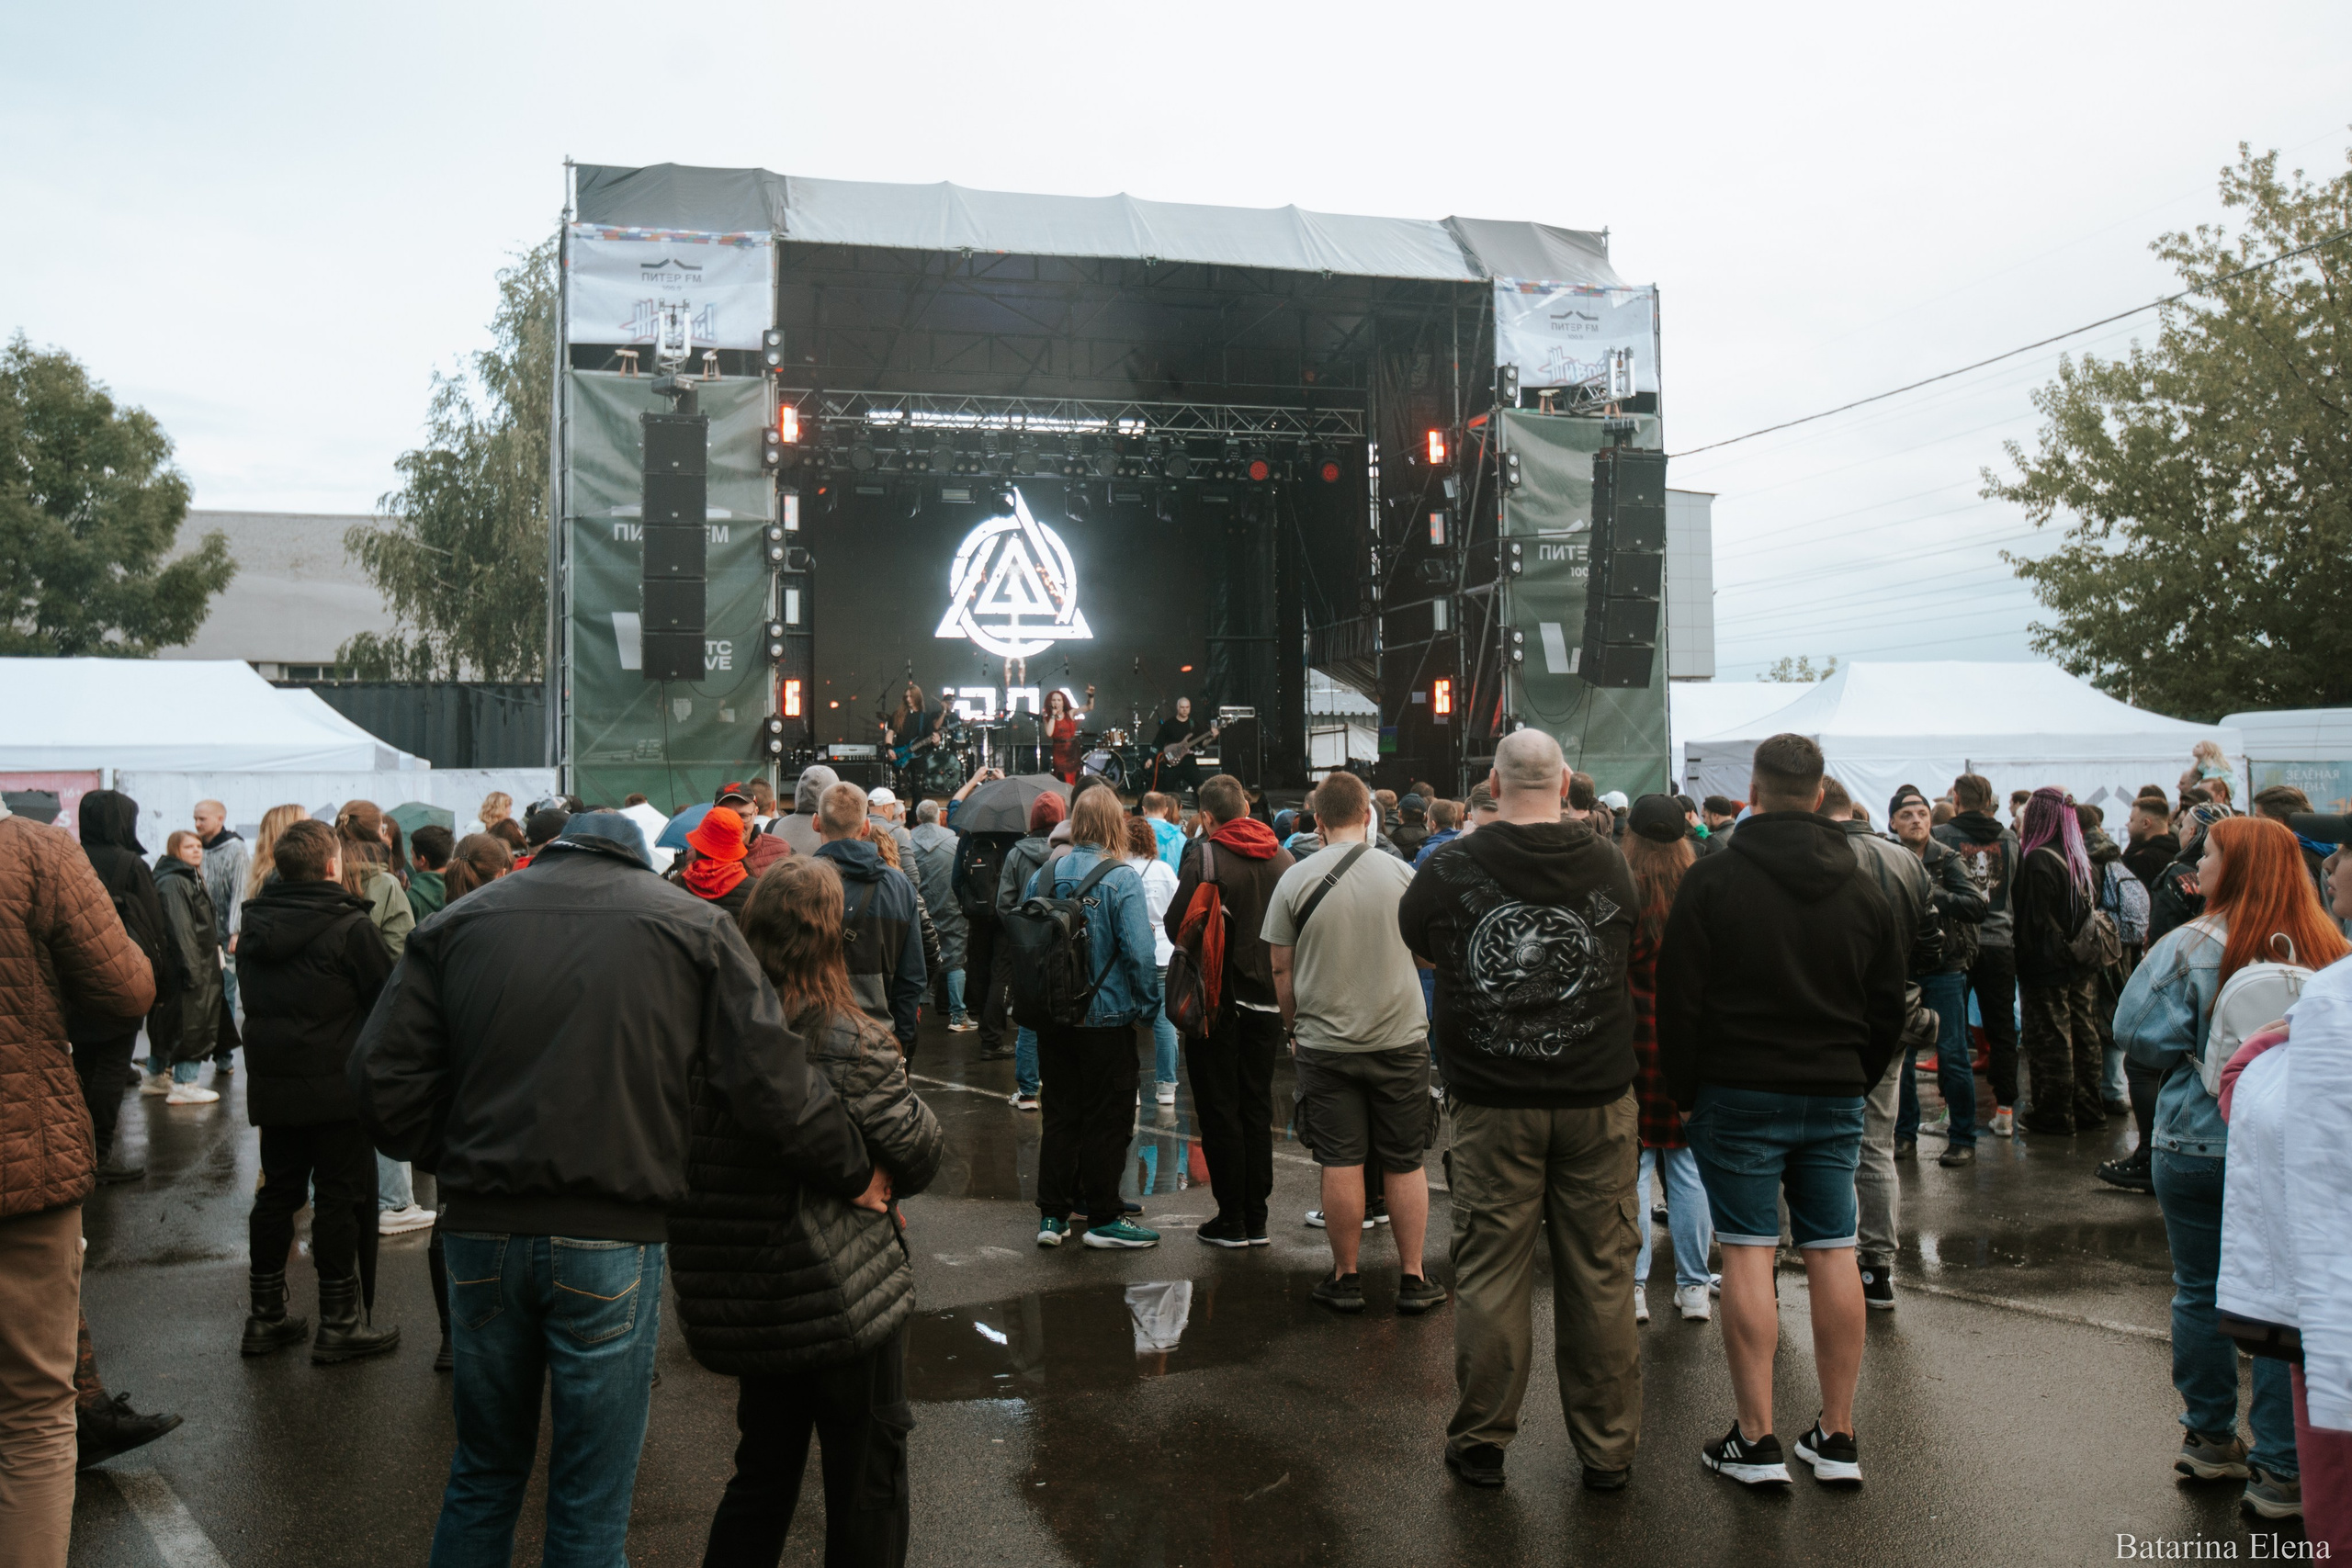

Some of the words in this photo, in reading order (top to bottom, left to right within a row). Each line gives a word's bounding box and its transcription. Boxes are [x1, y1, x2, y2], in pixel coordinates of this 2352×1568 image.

[642, 272, 681, 282] ПИТЕР
[685, 274, 701, 282] FM
[1551, 322, 1582, 332] ПИТЕР
[1586, 323, 1599, 332] FM
[1539, 545, 1589, 560] ПИТЕ
[1570, 567, 1589, 577] 100
[2286, 767, 2339, 780] ЗЕЛЁНАЯ
